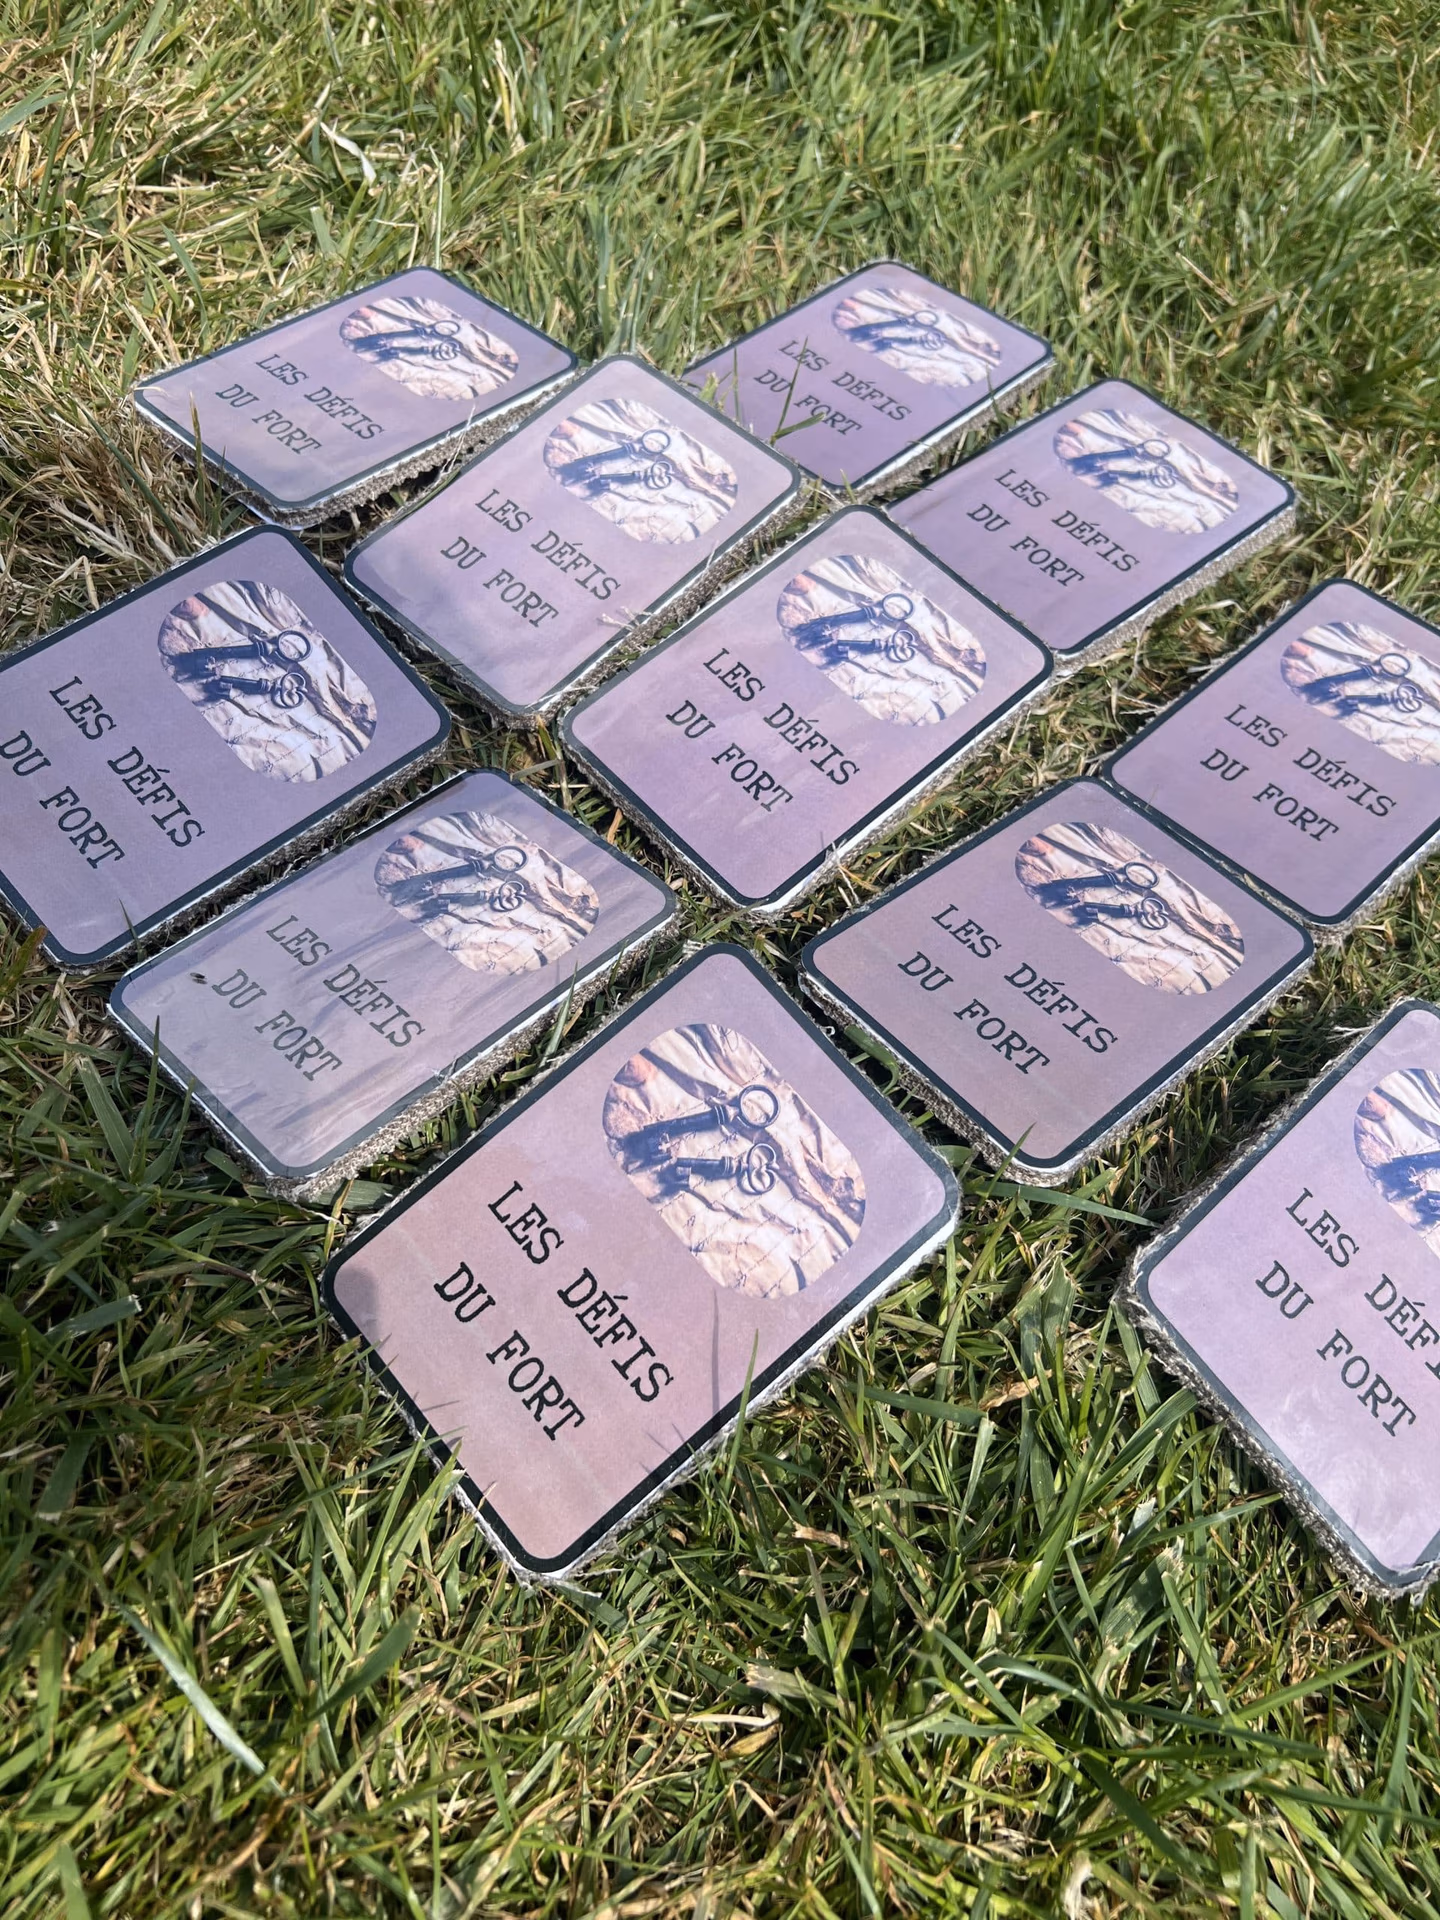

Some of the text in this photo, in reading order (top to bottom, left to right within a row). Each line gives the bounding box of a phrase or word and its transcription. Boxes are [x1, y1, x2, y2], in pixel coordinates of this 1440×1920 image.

[215, 384, 322, 454] DU FORT
[256, 354, 385, 440] LES DÉFIS
[754, 369, 862, 435] DU FORT
[779, 340, 912, 421] LES DÉFIS
[475, 489, 621, 601] LES DÉFIS
[967, 504, 1085, 587] DU FORT
[995, 469, 1140, 573] LES DÉFIS
[440, 536, 559, 627] DU FORT
[49, 676, 206, 847] LES DÉFIS
[666, 701, 793, 812] DU FORT
[703, 648, 860, 785] LES DÉFIS
[1224, 704, 1397, 815] LES DÉFIS
[0, 730, 125, 869] DU FORT
[1200, 749, 1340, 842] DU FORT
[211, 969, 342, 1081] DU FORT
[266, 915, 333, 966] LES
[323, 964, 425, 1047] DÉFIS
[898, 951, 1051, 1075] DU FORT
[931, 904, 1001, 958] LES
[1004, 962, 1118, 1055] DÉFIS
[1286, 1188, 1360, 1268] LES
[488, 1181, 674, 1402] LES DÉFIS
[434, 1262, 585, 1441] DU FORT
[1256, 1260, 1416, 1438] DU FORT
